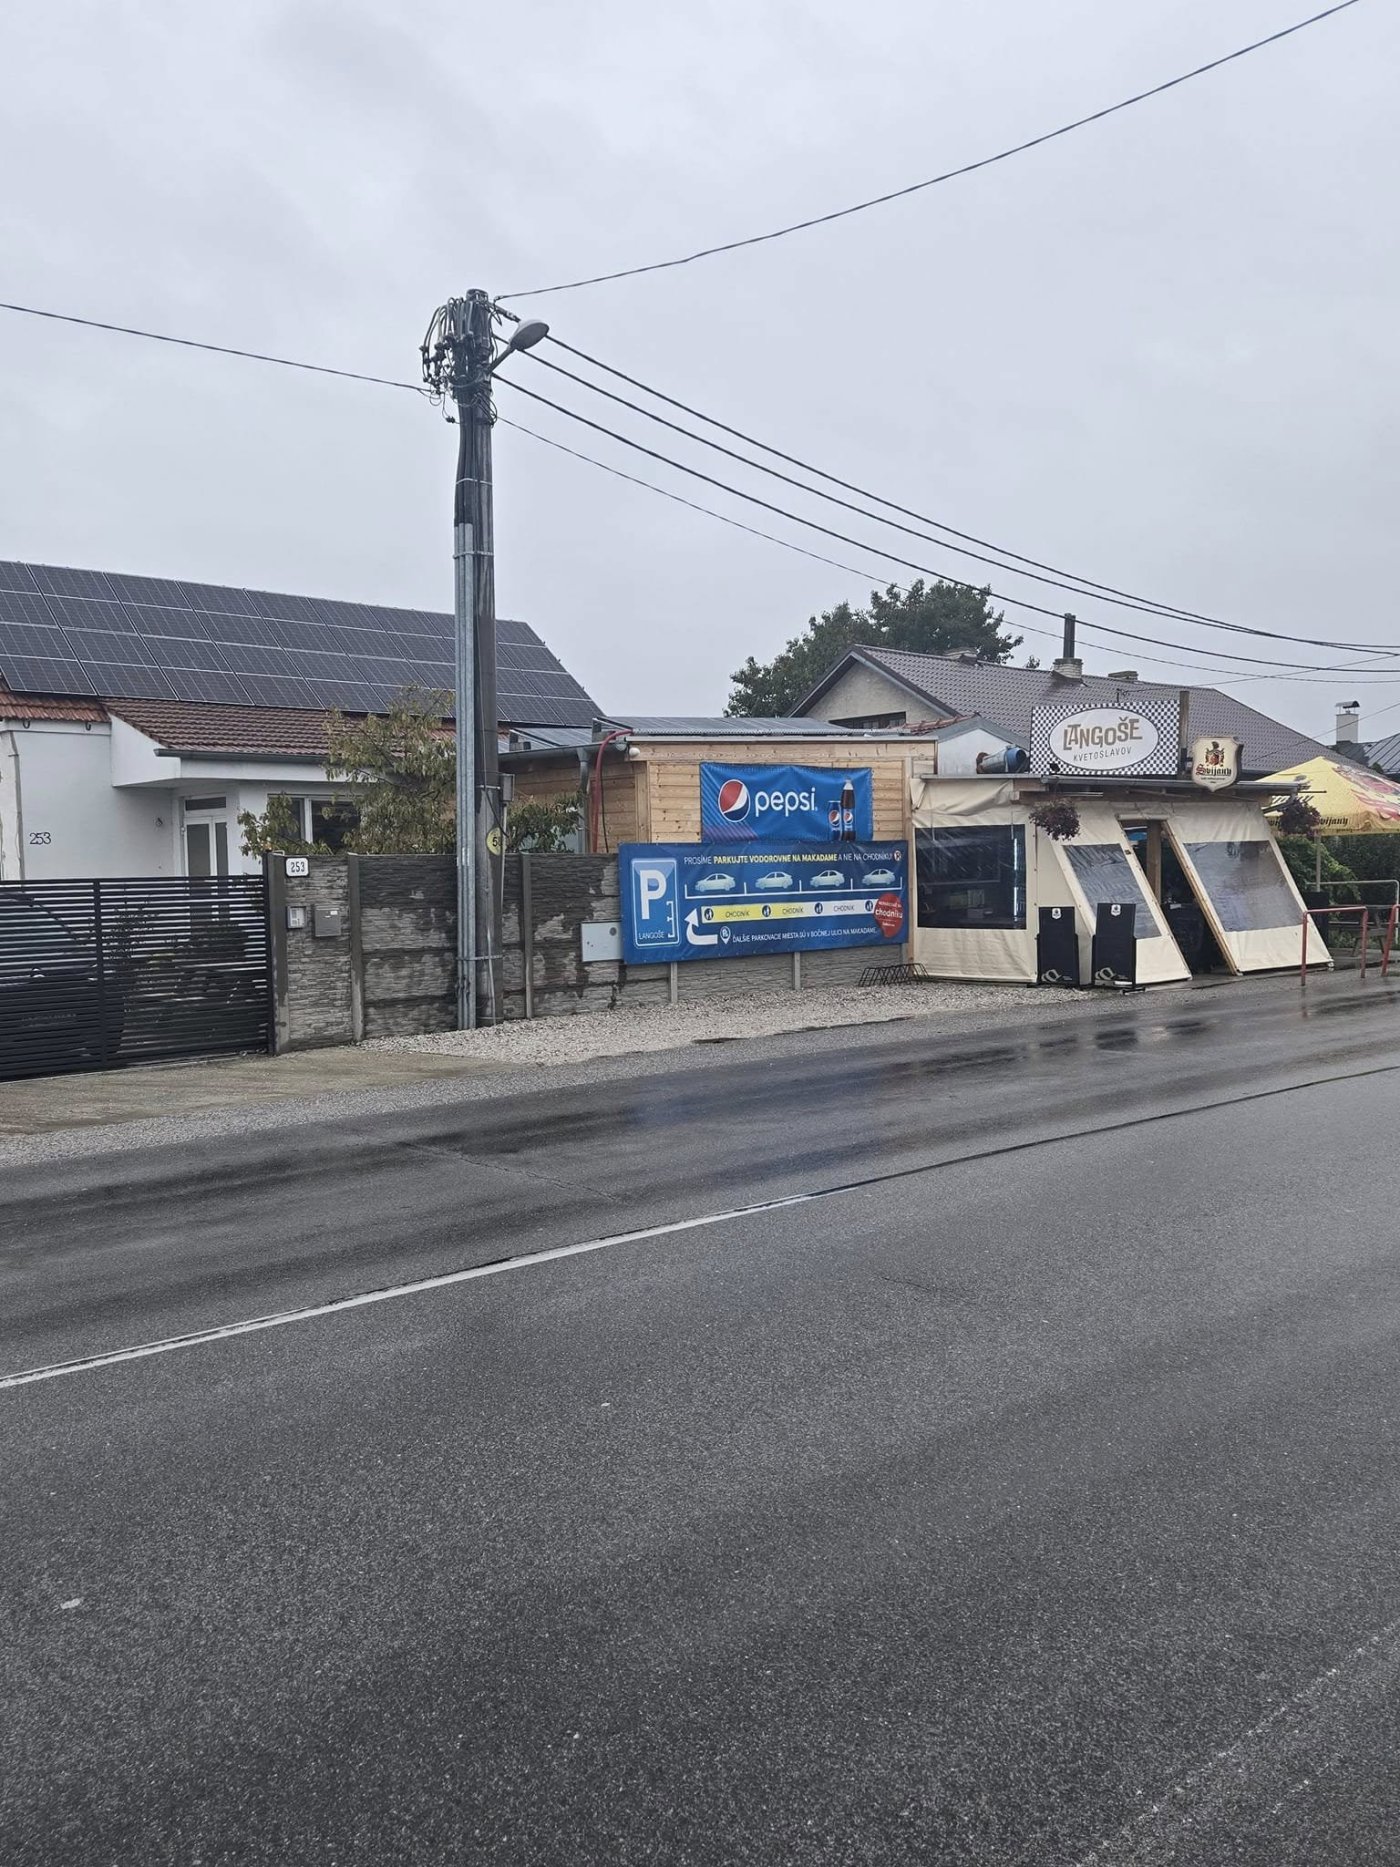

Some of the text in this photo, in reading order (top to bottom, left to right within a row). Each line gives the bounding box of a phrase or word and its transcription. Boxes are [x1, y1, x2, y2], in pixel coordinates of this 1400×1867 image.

[1063, 716, 1142, 751] LANGOŠE
[1073, 746, 1132, 762] KVETOSLAVOV
[1195, 764, 1231, 776] Svijany
[755, 787, 816, 817] pepsi
[29, 832, 52, 845] 253
[714, 855, 748, 864] PARKUJTE
[749, 854, 791, 863] VODOROVNE
[792, 853, 801, 862] NA
[802, 852, 837, 862] MAKADAME
[838, 853, 843, 861] A
[854, 852, 862, 861] NA
[290, 861, 305, 873] 253
[639, 869, 667, 920] P
[725, 904, 855, 919] CHODNÍK CHODNÍK CHODNÍK
[638, 929, 665, 940] LANGOŠE
[782, 931, 799, 939] MIESTA
[799, 929, 806, 938] SÚ
[811, 928, 831, 937] BOČNEJ
